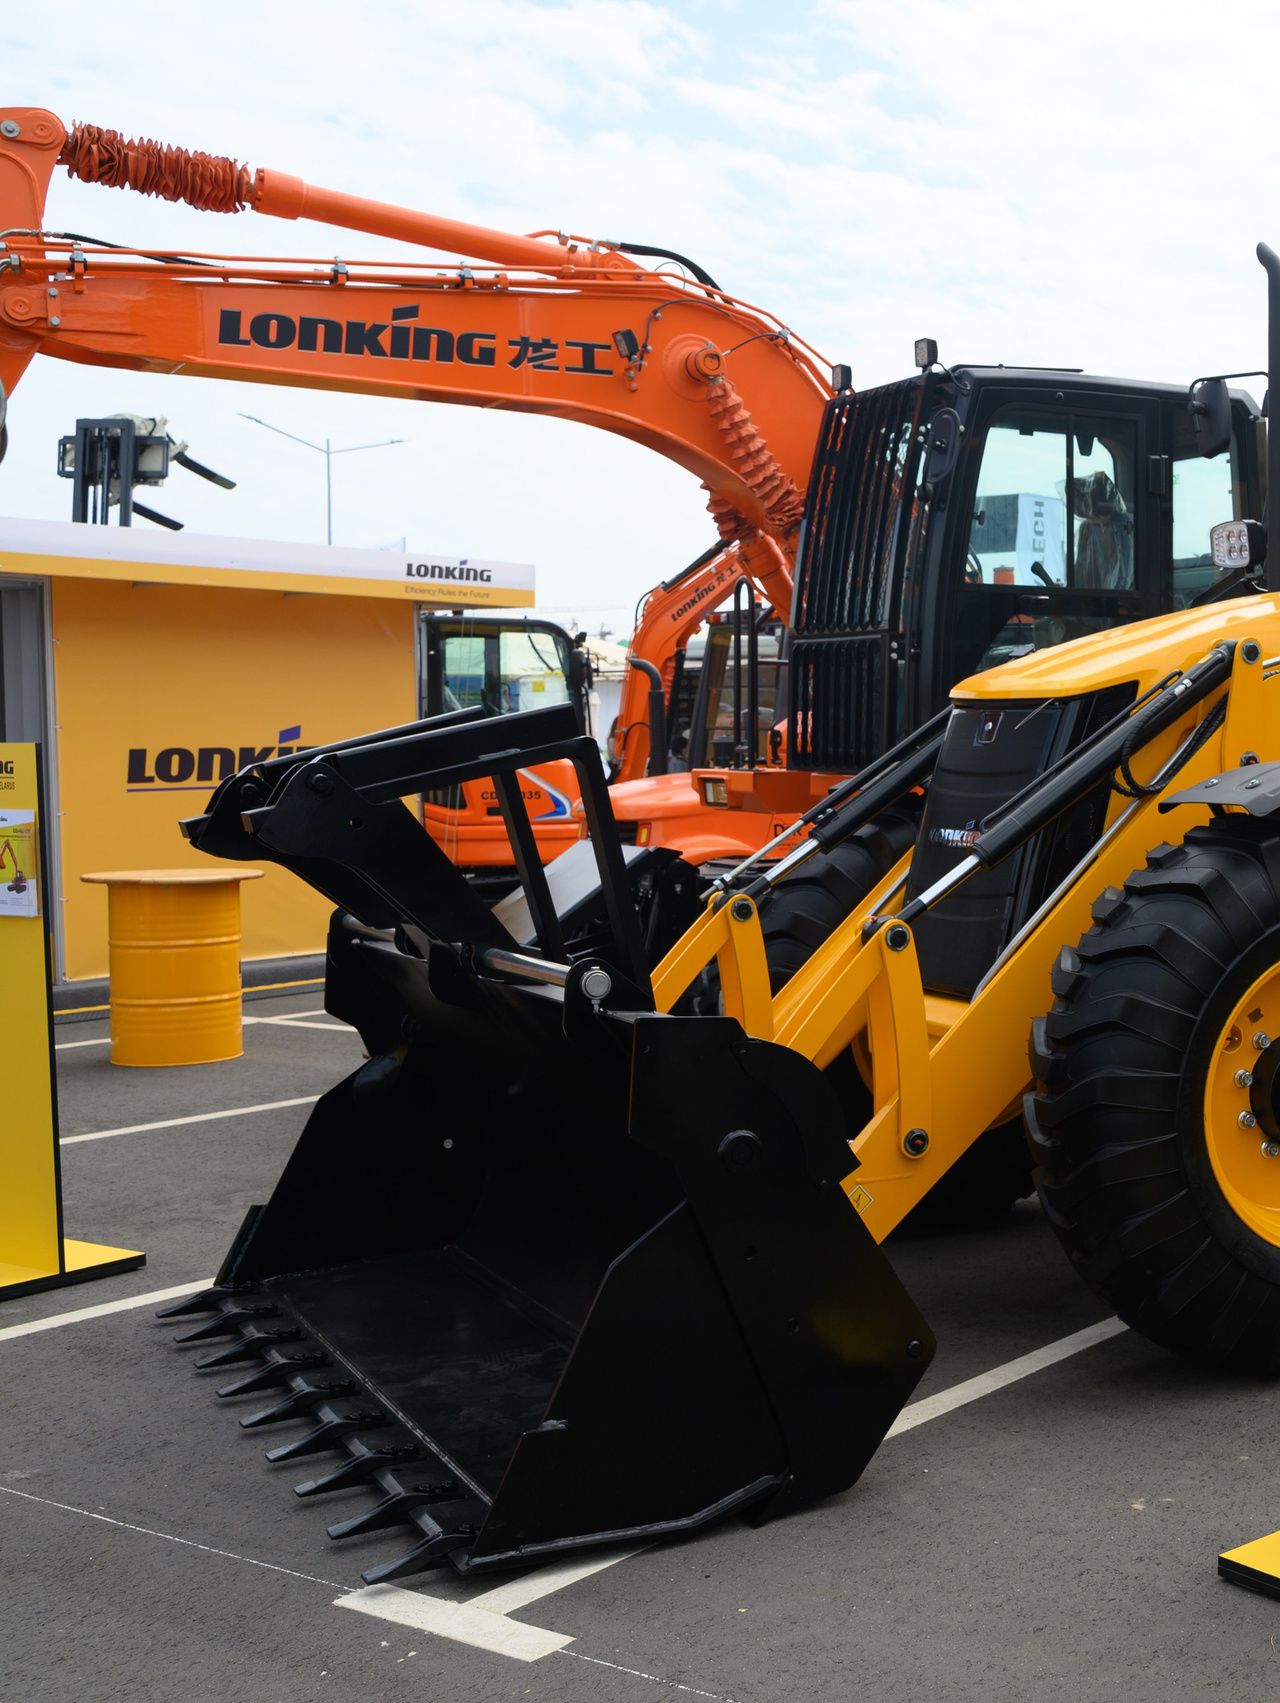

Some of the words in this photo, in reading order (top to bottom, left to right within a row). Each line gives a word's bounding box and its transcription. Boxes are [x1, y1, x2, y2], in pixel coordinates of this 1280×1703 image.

[218, 303, 496, 367] LONKING
[507, 335, 614, 377] 龙工
[406, 559, 492, 582] LONKING
[458, 589, 469, 597] the
